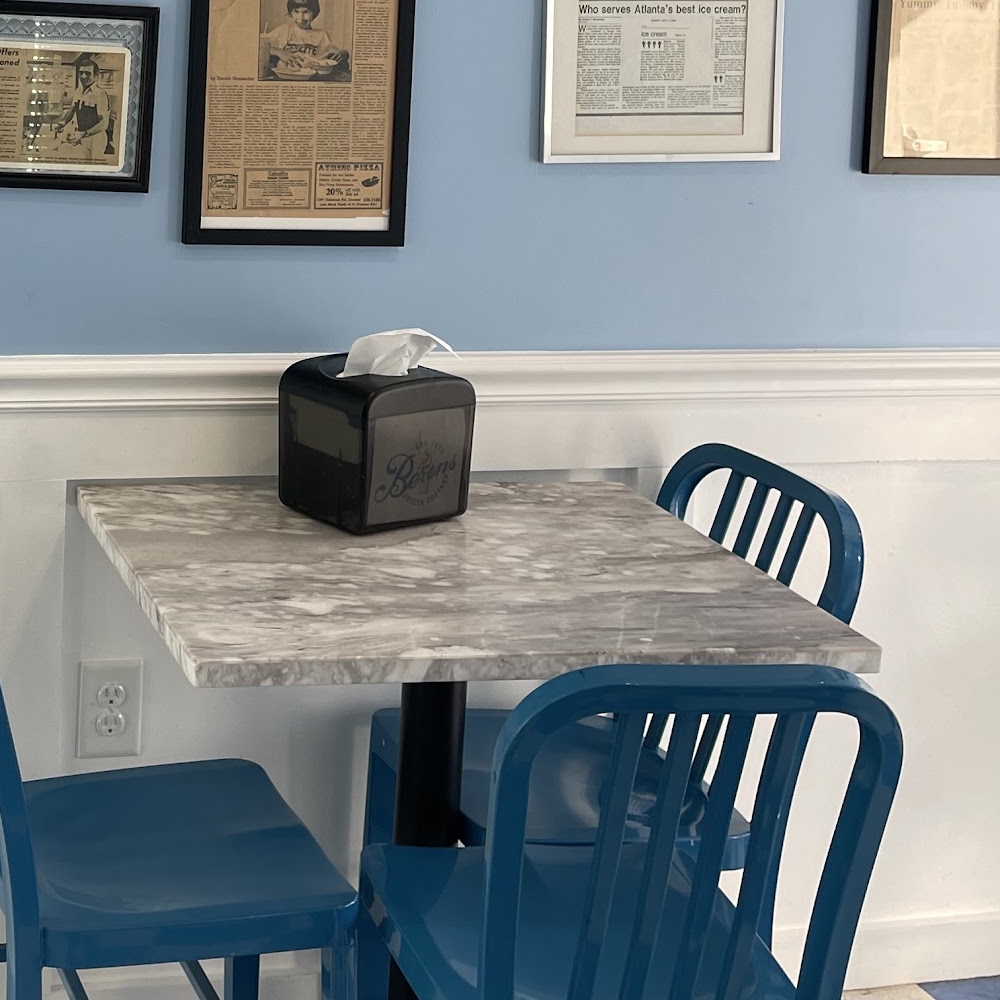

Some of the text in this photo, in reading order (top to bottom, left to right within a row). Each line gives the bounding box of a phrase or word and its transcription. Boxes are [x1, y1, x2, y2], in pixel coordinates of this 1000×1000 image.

[579, 5, 598, 14] Who
[635, 5, 673, 14] Atlanta's
[715, 6, 746, 14] cream?
[326, 188, 343, 196] 20%
[374, 453, 457, 503] Berens
